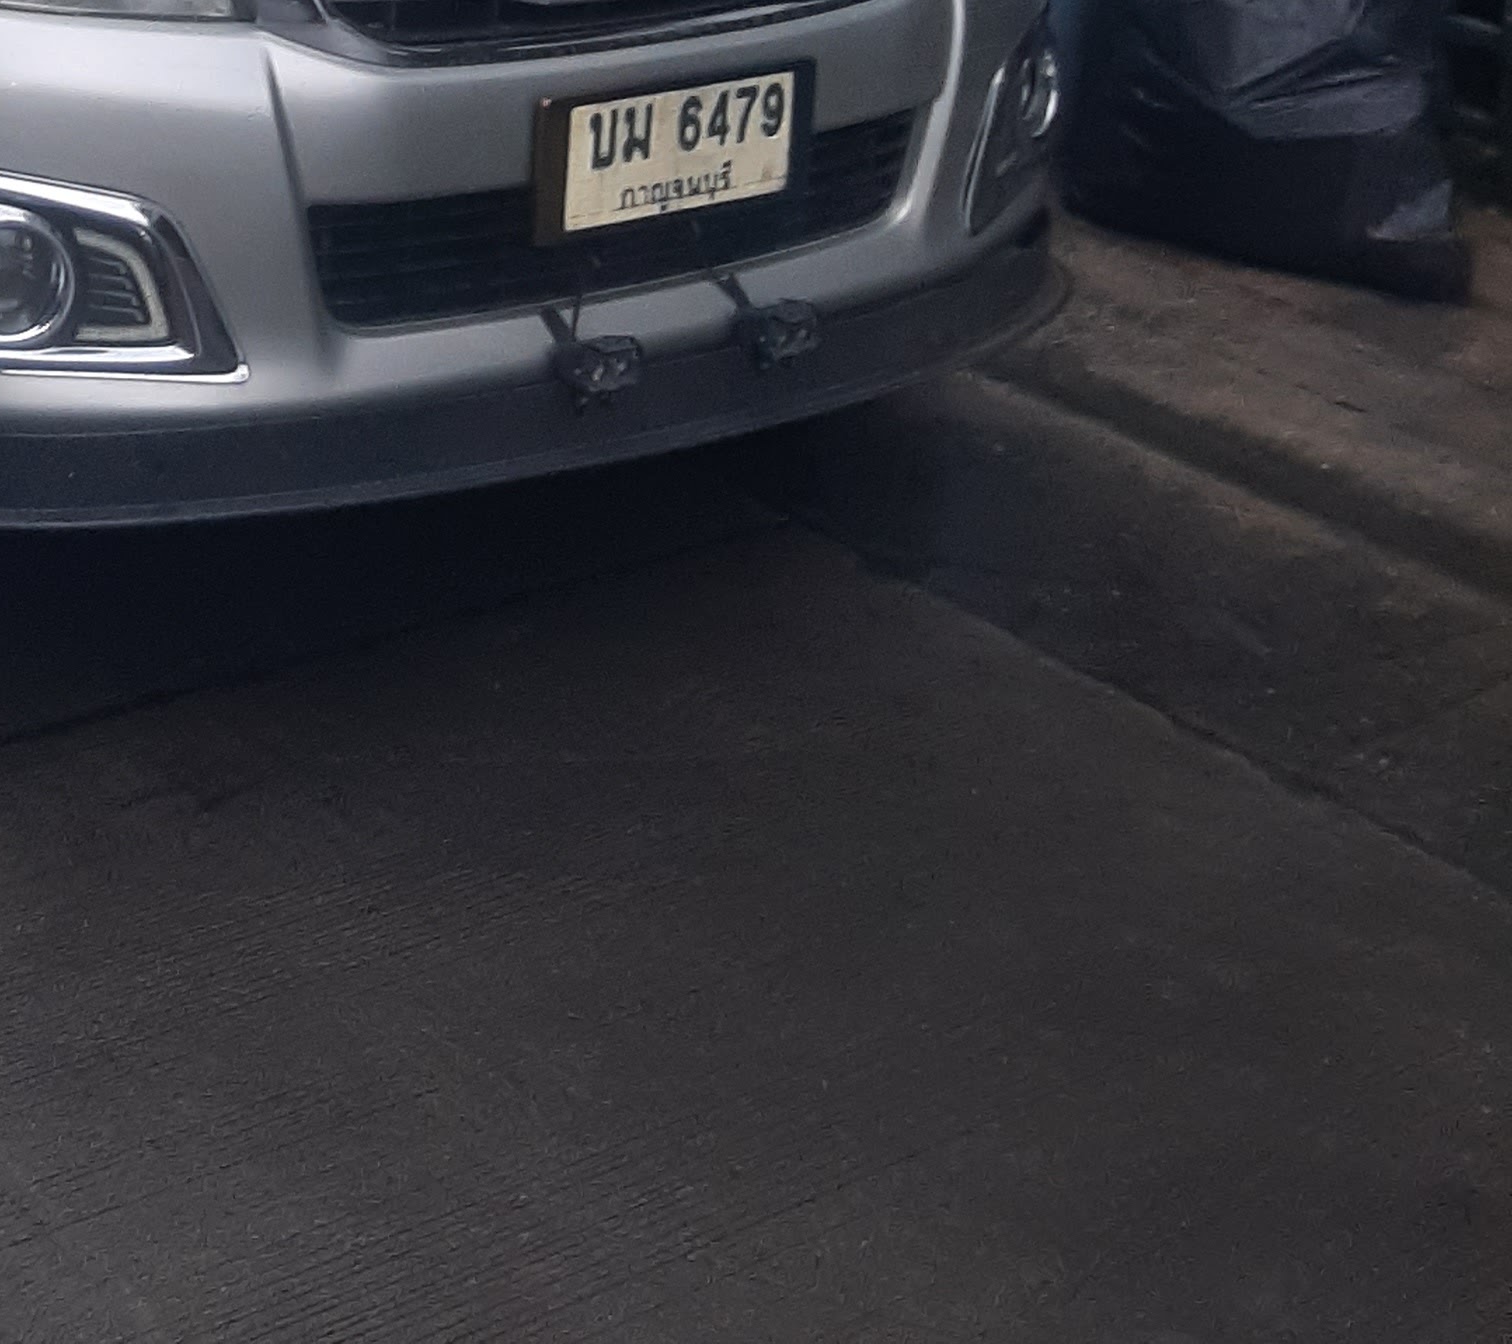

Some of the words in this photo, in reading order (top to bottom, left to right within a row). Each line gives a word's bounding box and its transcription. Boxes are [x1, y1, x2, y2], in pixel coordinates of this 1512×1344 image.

[589, 102, 653, 171] บม
[678, 82, 785, 152] 6479
[619, 159, 732, 211] กาญจนบุรี
